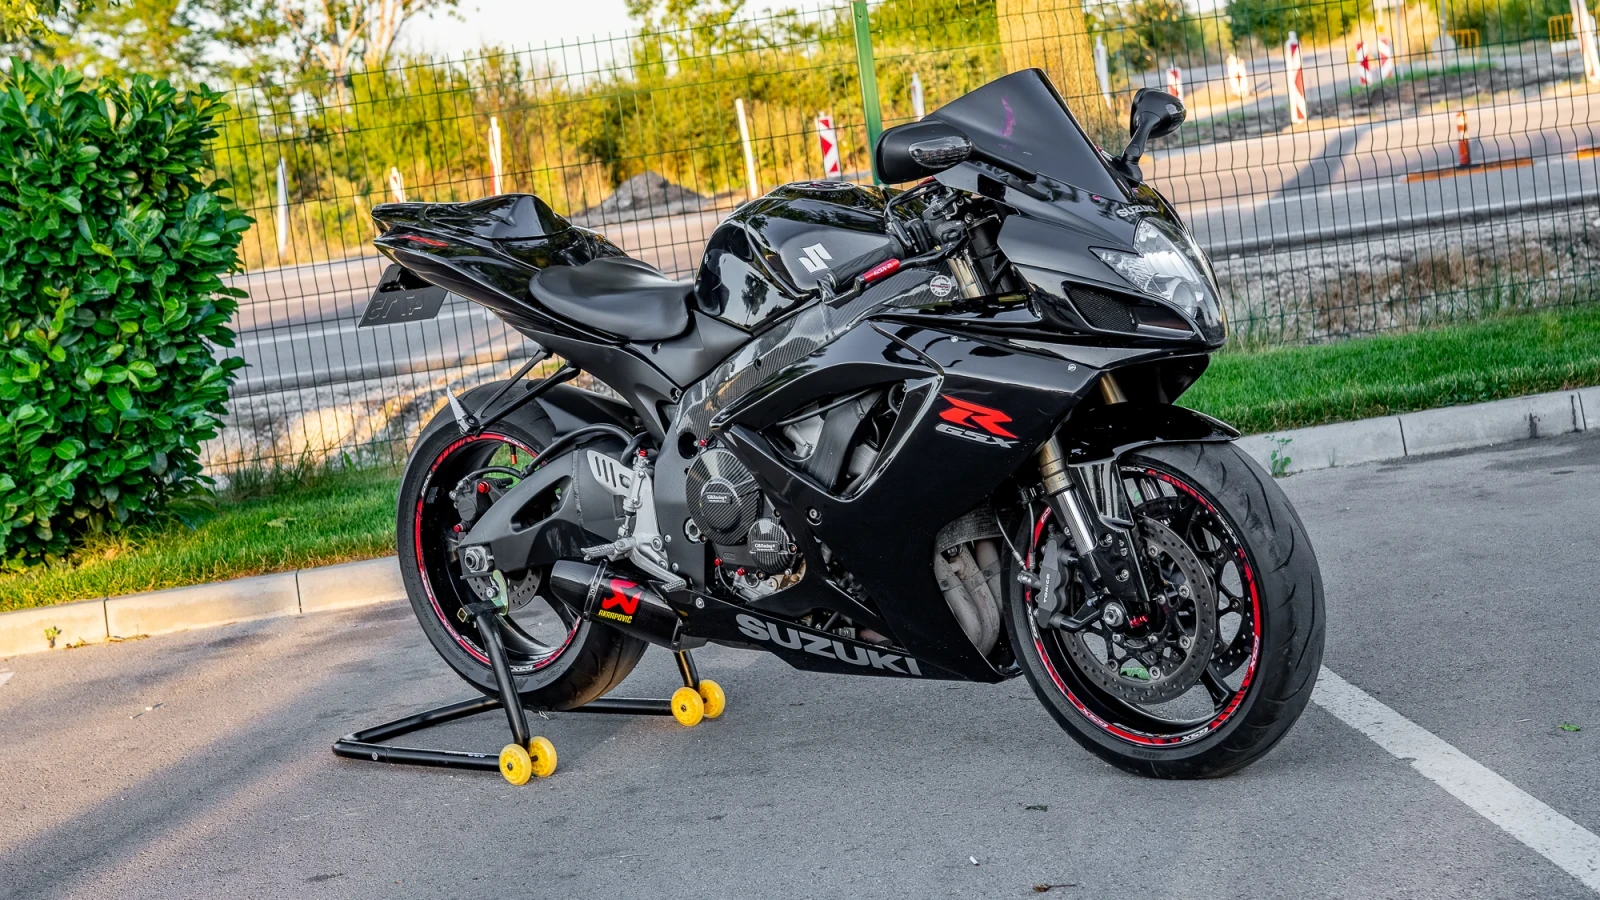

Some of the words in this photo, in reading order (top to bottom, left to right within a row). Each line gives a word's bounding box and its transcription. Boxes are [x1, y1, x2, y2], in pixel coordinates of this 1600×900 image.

[935, 423, 1020, 448] GSX
[939, 393, 1019, 439] R
[735, 613, 922, 676] SUZUKI
